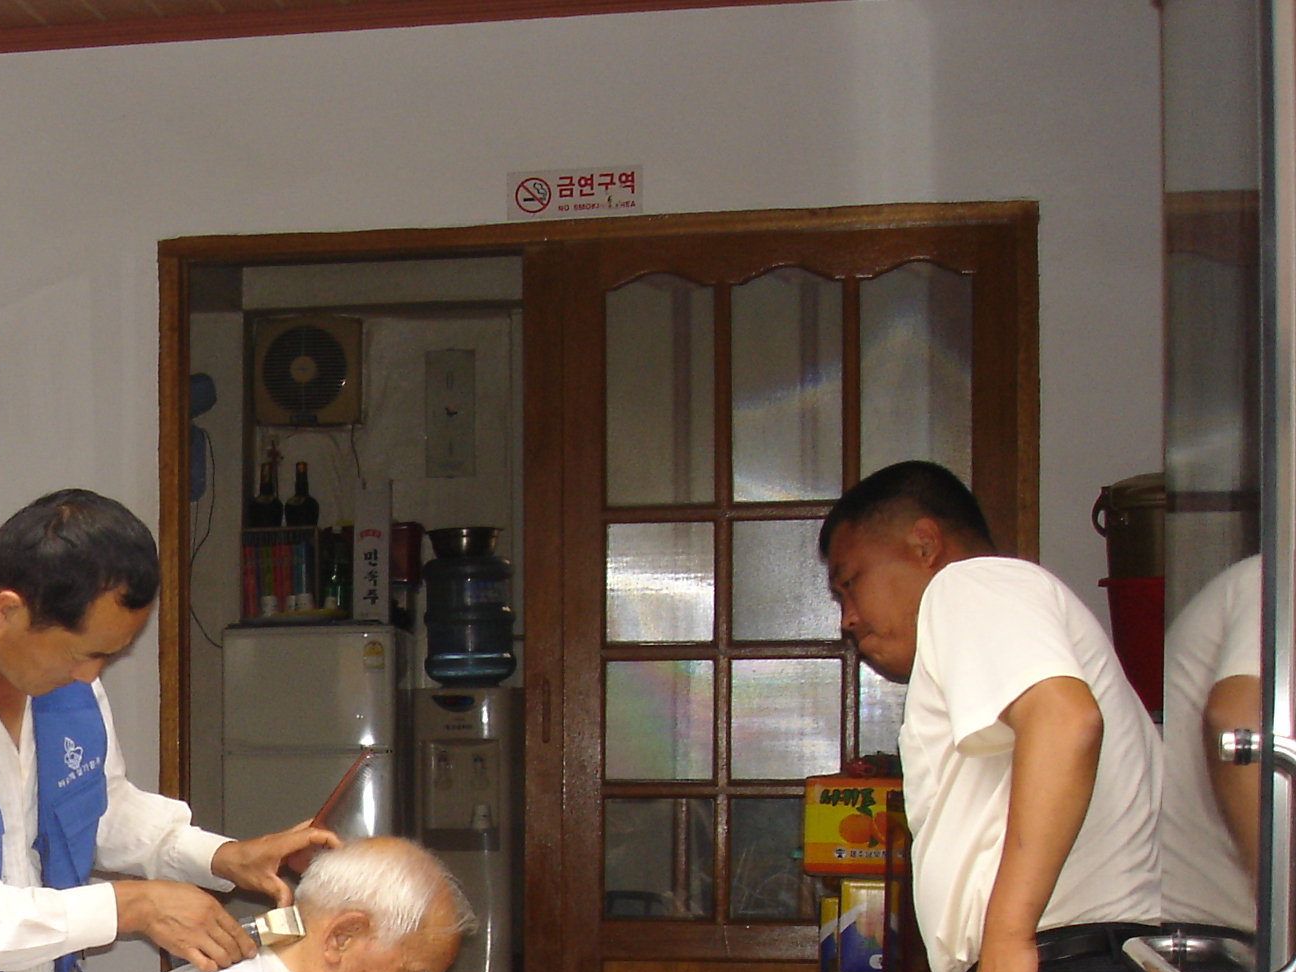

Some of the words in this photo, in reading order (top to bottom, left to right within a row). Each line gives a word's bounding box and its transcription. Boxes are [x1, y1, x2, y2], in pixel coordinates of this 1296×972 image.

[556, 170, 637, 198] 금연구역
[557, 204, 570, 212] NO
[573, 202, 607, 211] SMOKI
[363, 548, 379, 606] 민속주
